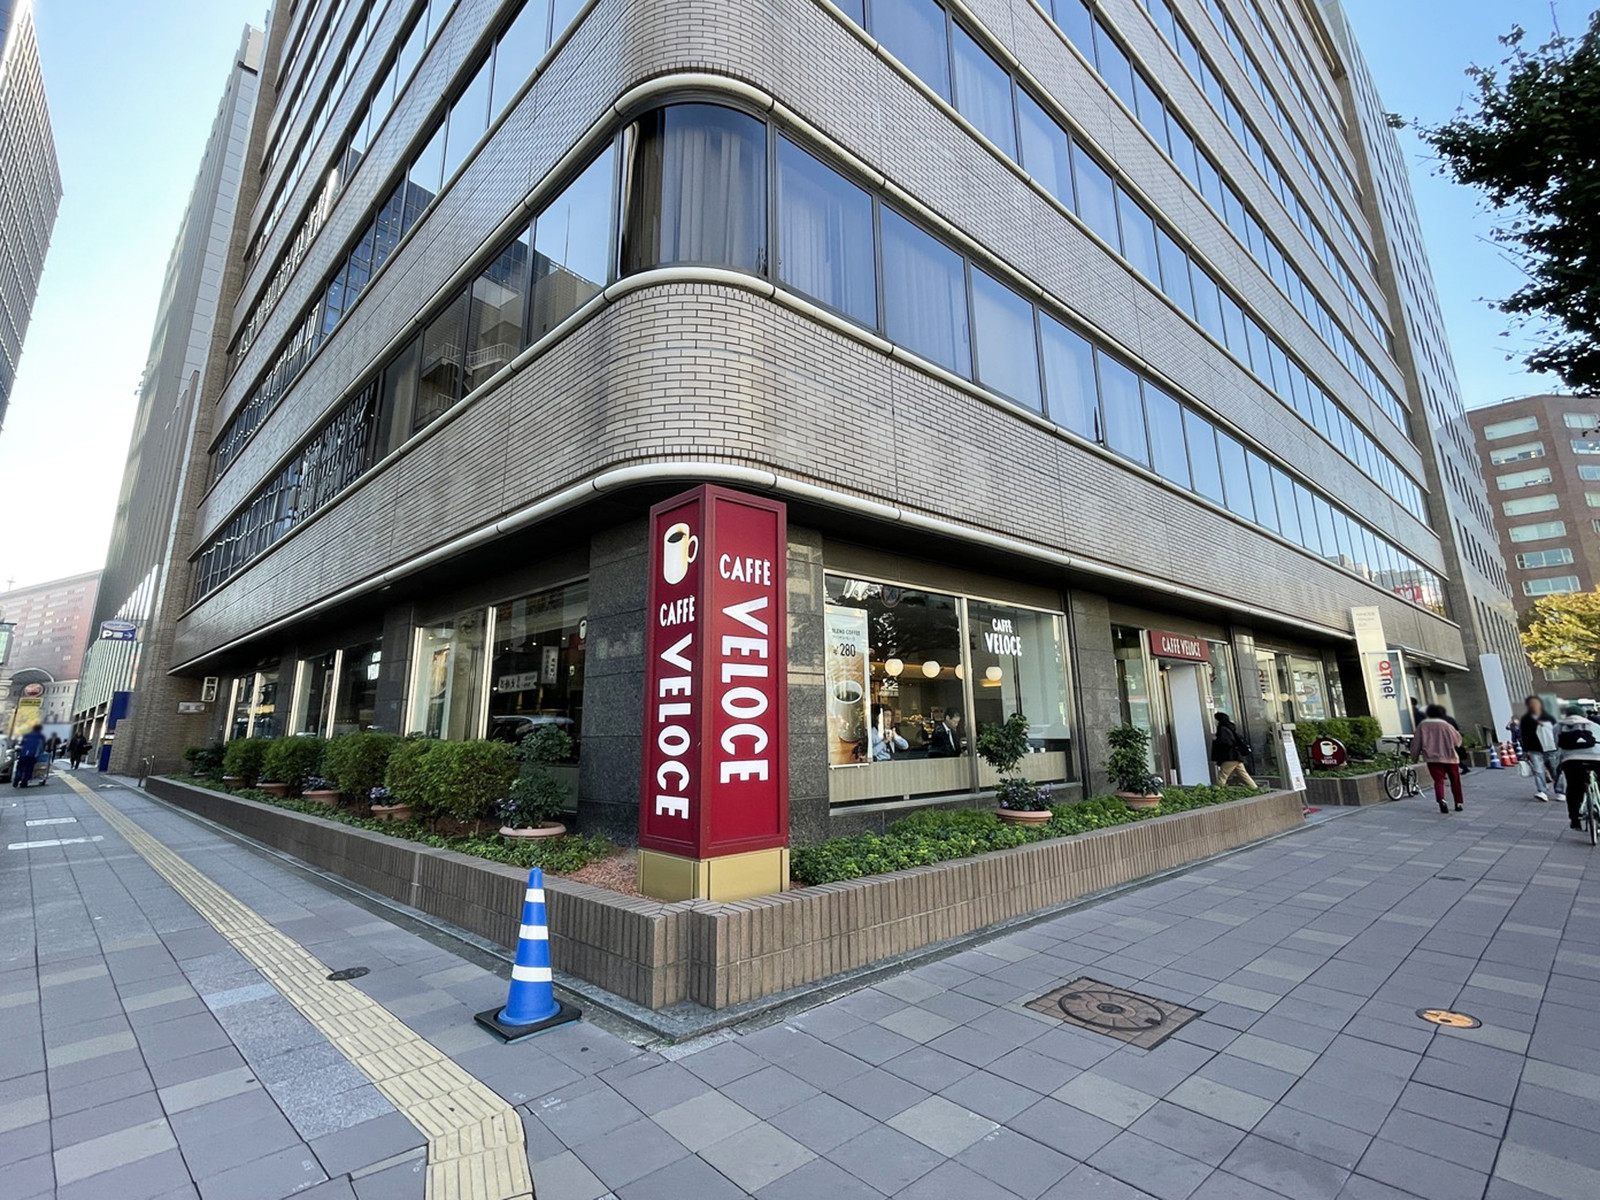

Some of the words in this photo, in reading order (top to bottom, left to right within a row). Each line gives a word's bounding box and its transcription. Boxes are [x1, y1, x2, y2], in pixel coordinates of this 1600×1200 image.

[719, 553, 771, 586] CAFFÈ
[660, 594, 695, 627] CAFFÈ
[984, 631, 1022, 657] VELOCE
[1180, 639, 1201, 657] VELOCE
[720, 596, 768, 784] VELOCE
[655, 632, 692, 820] VELOCE
